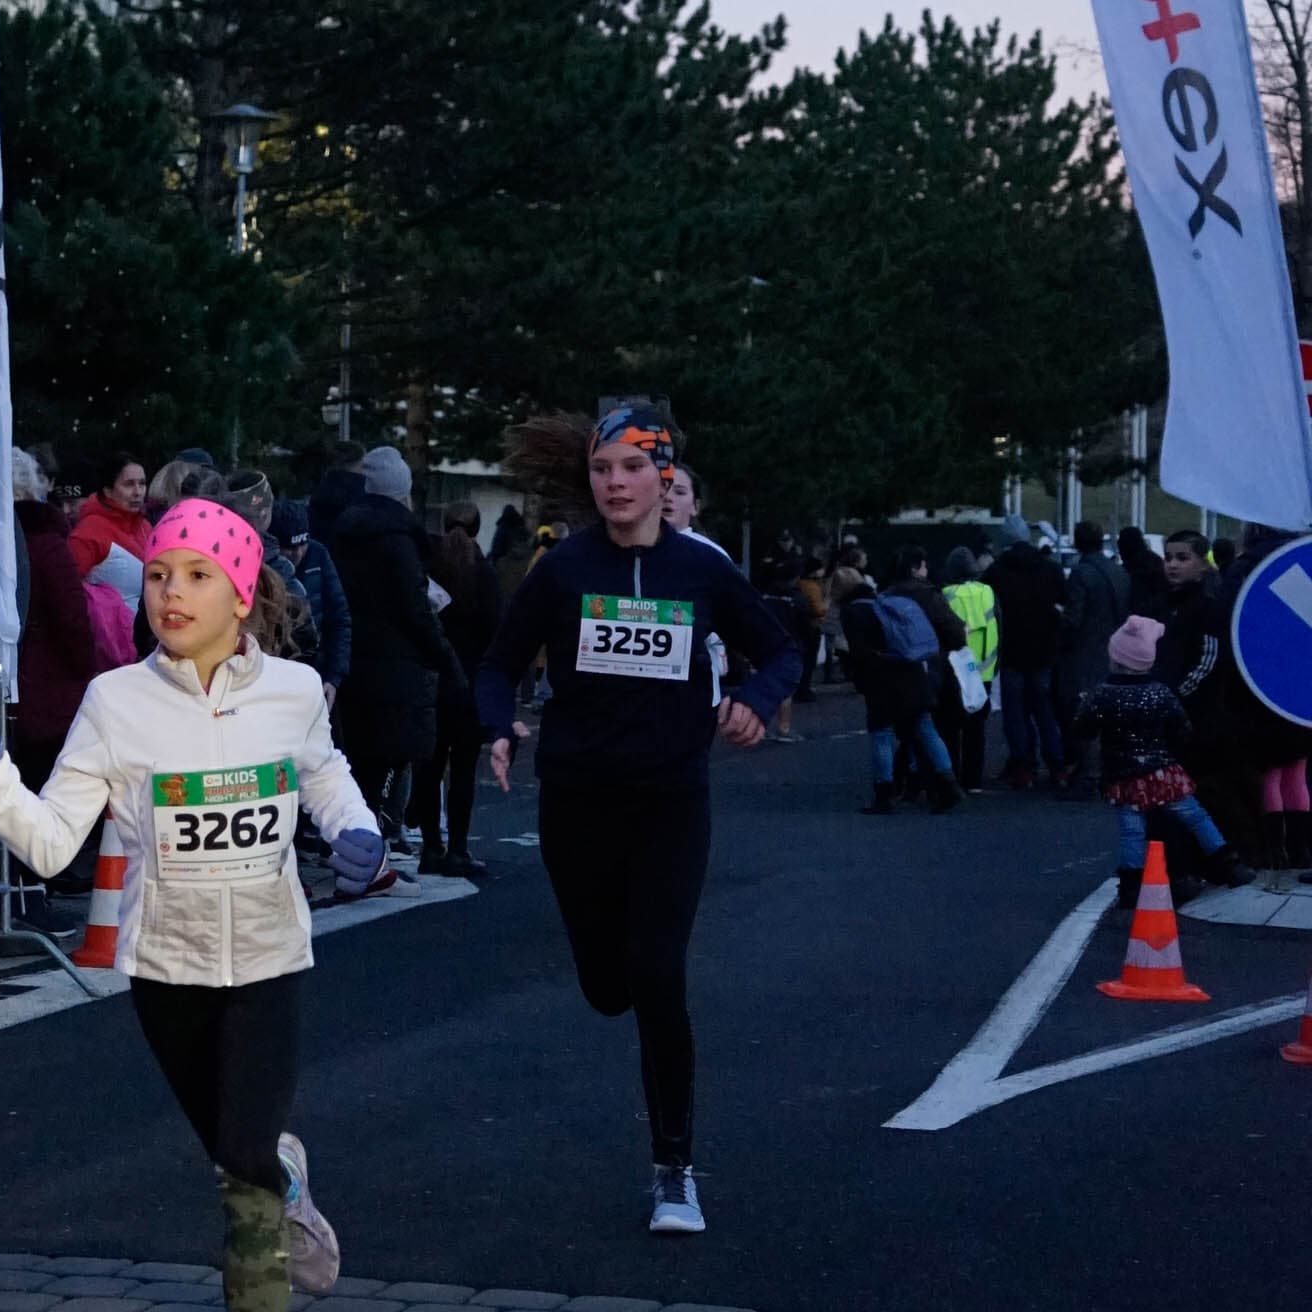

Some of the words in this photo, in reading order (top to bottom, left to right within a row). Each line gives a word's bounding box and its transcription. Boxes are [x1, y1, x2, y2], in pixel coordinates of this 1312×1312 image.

[632, 599, 658, 612] KIDS
[593, 625, 673, 658] 3259
[223, 769, 258, 786] KIDS
[174, 805, 280, 852] 3262
